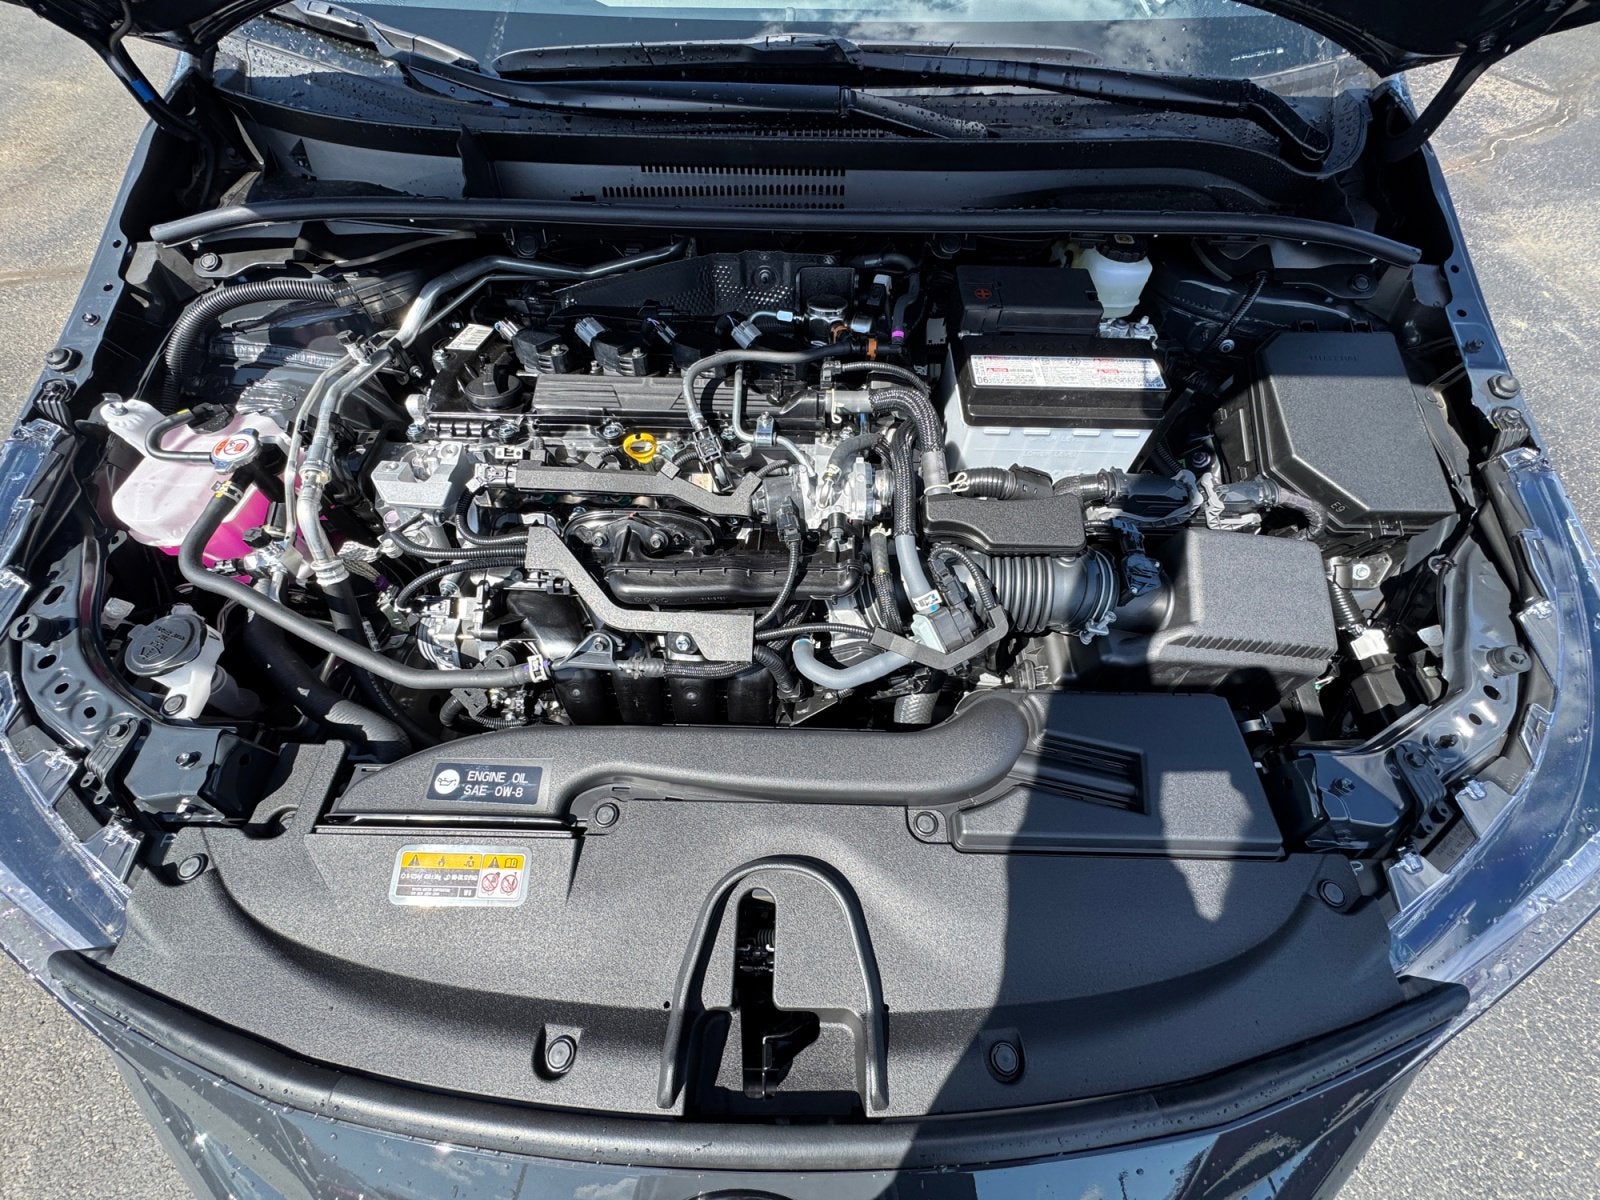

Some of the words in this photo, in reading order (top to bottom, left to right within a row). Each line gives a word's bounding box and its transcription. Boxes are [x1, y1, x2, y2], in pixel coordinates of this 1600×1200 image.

[467, 770, 507, 783] ENGINE
[512, 772, 529, 784] OIL
[463, 784, 488, 796] SAE
[494, 786, 524, 798] 0W-8
